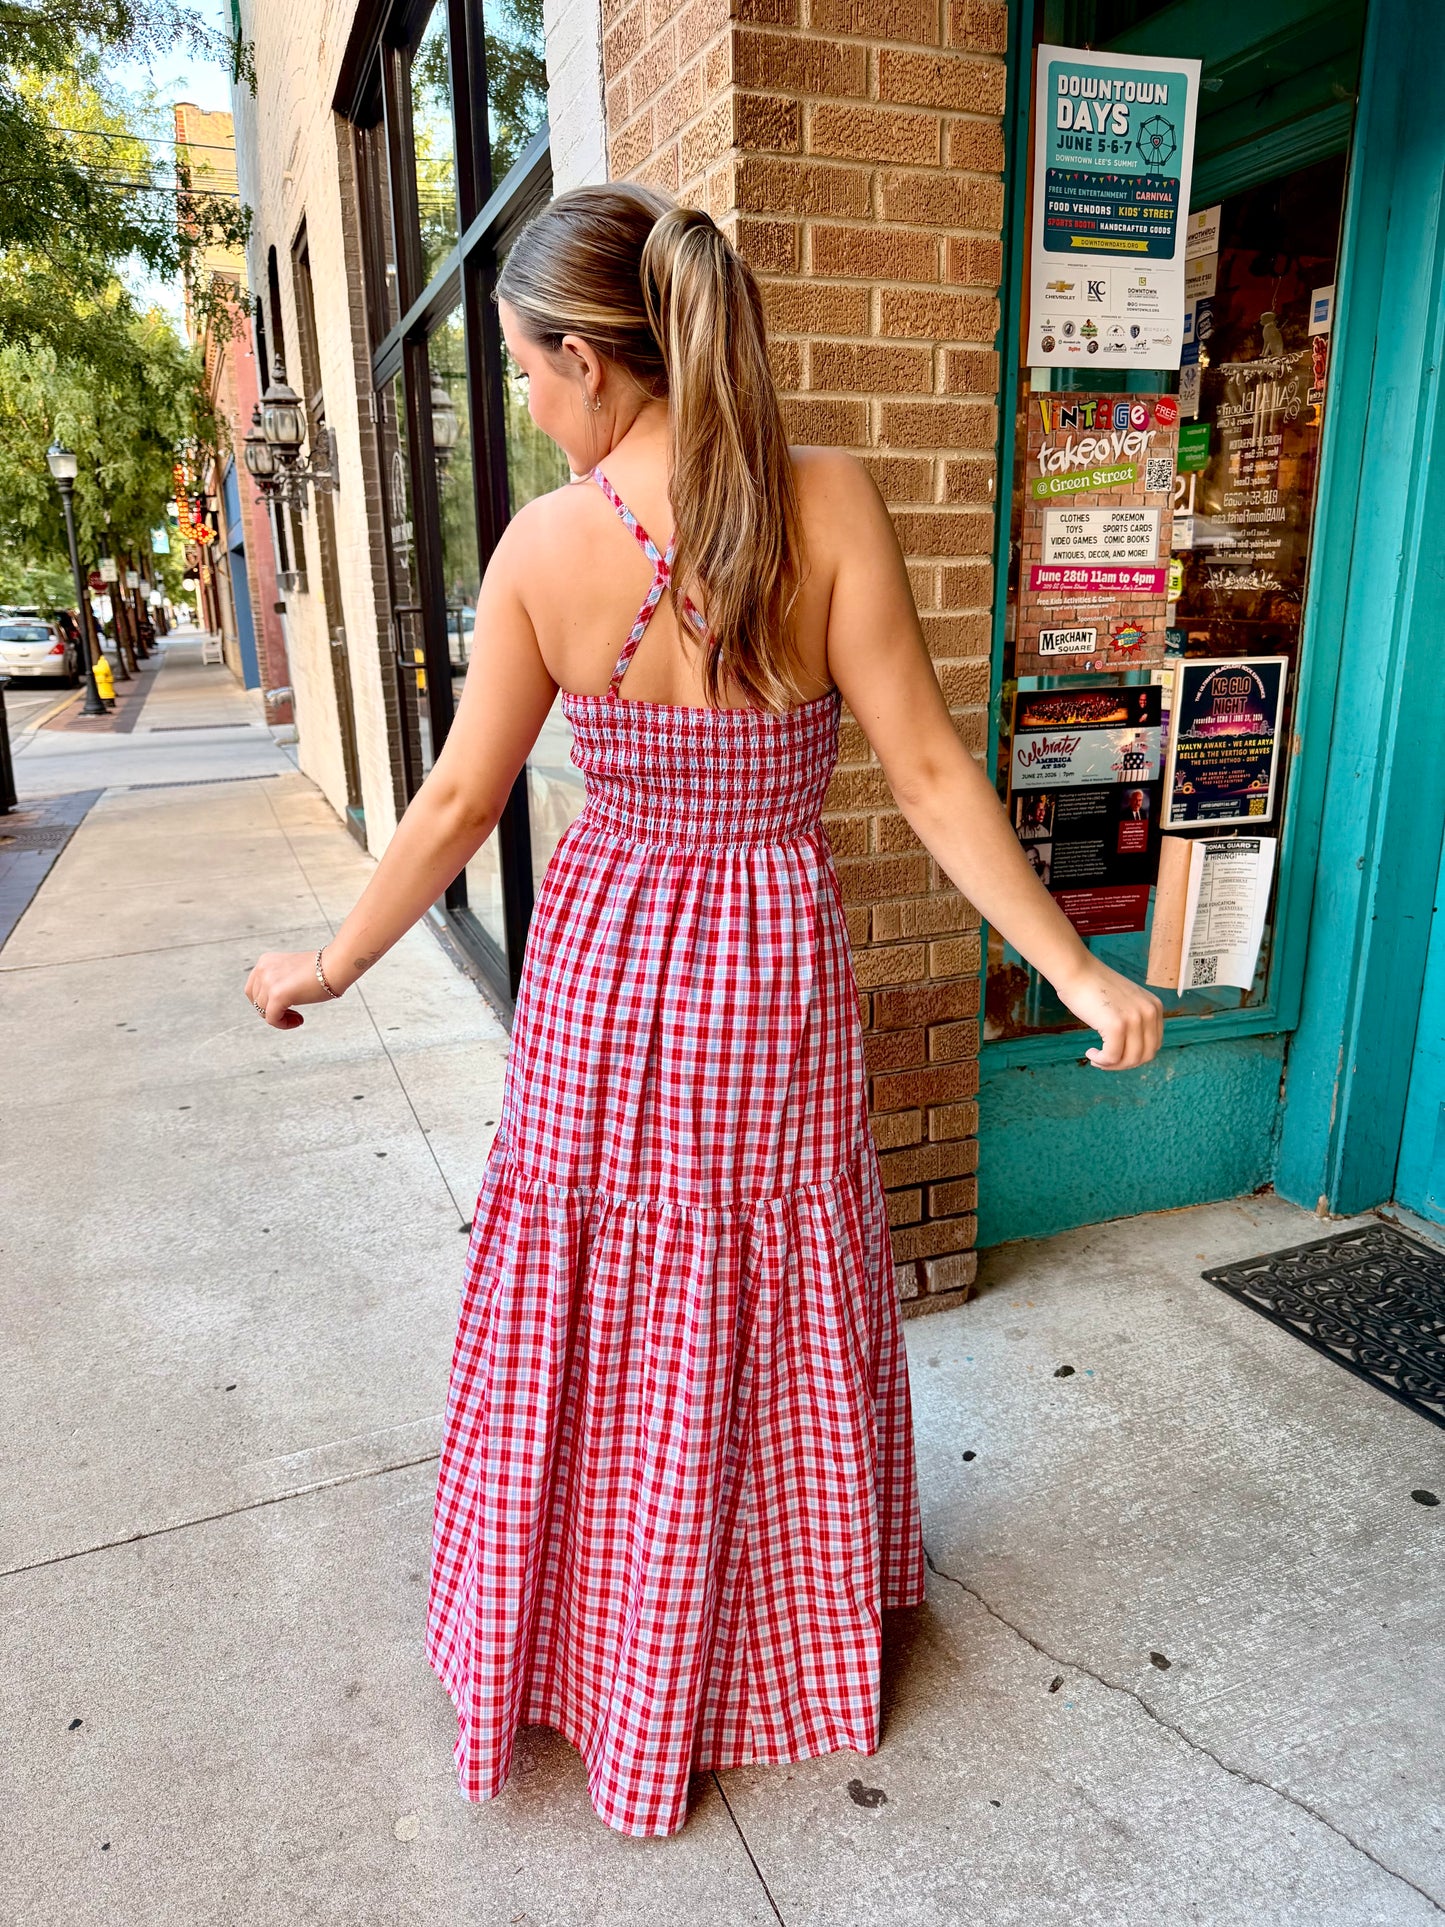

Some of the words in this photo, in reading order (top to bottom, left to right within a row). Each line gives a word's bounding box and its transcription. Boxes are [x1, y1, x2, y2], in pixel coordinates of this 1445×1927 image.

[1058, 75, 1168, 105] DOWNTOWN
[1057, 97, 1129, 135] DAYS
[1057, 135, 1092, 152] JUNE
[1098, 139, 1132, 154] 5-6-7
[1056, 154, 1092, 164] DOWNTOWN
[1094, 158, 1111, 166] LEE'S
[1114, 160, 1138, 168] SUMMIT
[1049, 186, 1062, 194] FREE
[1078, 188, 1127, 199] ENTERTAINMENT
[1136, 191, 1173, 202] CARNIVAL
[1049, 201, 1069, 212] FOOD
[1073, 203, 1112, 215] VENDORS
[1118, 206, 1140, 217] KIDS'
[1143, 208, 1174, 219] STREET
[1048, 218, 1072, 228] SPORTS
[1100, 222, 1148, 233] HANDCRAFTED
[1150, 224, 1171, 234] GOODS
[1081, 239, 1139, 249] DOWNTOWNDAYS.ORG
[1087, 280, 1106, 302] KC
[1155, 404, 1176, 419] FREE
[1037, 430, 1156, 477] takeover
[1037, 482, 1047, 494] @
[1050, 476, 1090, 492] Green
[1092, 468, 1133, 485] Street
[1060, 514, 1090, 523] CLOTHES
[1112, 513, 1144, 522] POKEMON
[1066, 525, 1083, 534] TOYS
[1103, 525, 1129, 533] SPORTS
[1130, 524, 1152, 532] CARDS
[1051, 537, 1071, 545] VIDEO
[1073, 536, 1097, 544] GAMES
[1104, 536, 1126, 544] COMIC
[1127, 535, 1150, 543] BOOKS
[1053, 551, 1086, 560] ANTIQUES,
[1088, 551, 1111, 559] DECOR,
[1112, 550, 1126, 558] AND
[1036, 570, 1061, 585] June
[1063, 570, 1088, 582] 28th
[1090, 571, 1116, 583] 11am
[1119, 572, 1129, 583] to
[1132, 572, 1155, 585] 4pm
[1058, 645, 1092, 653] SQUARE
[1212, 678, 1228, 696] KC
[1229, 676, 1251, 694] GLO
[1213, 697, 1247, 715] NIGHT
[1018, 735, 1082, 768] Celebrate!
[1177, 743, 1202, 751] EVALYN
